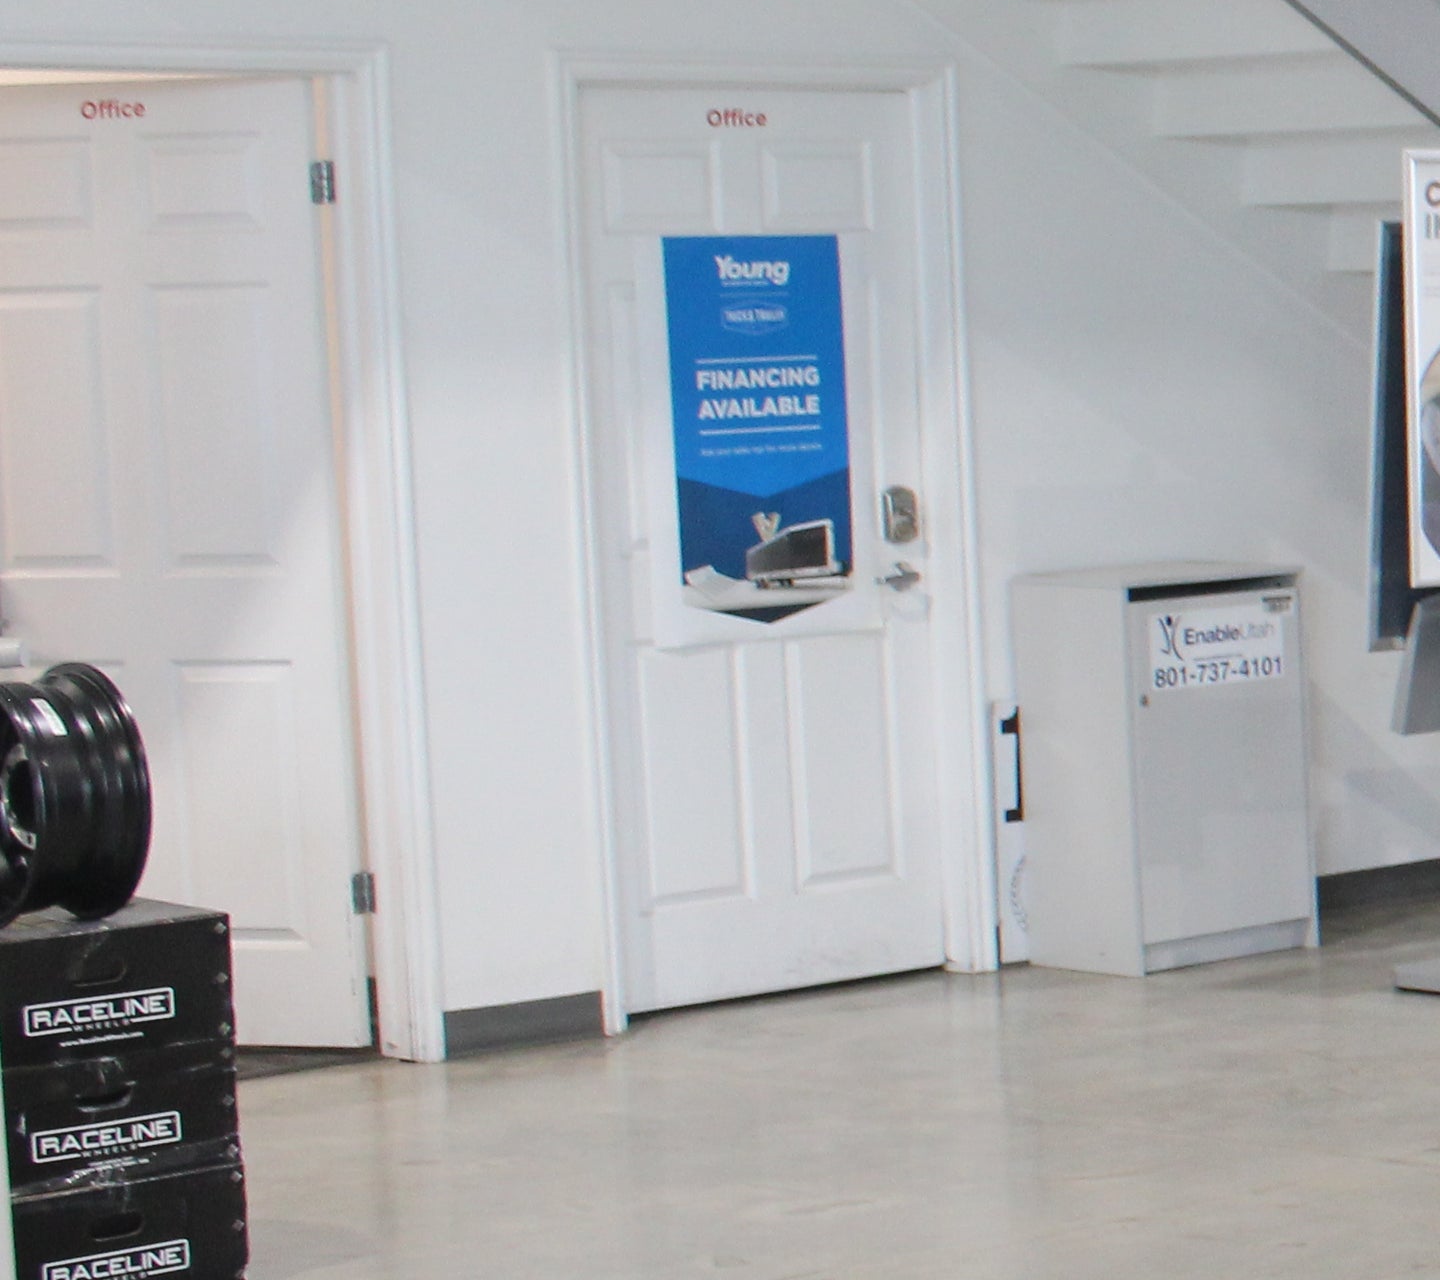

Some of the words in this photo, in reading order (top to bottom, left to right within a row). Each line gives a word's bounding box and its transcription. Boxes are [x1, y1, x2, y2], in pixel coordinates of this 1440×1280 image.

[81, 100, 146, 119] Office
[706, 108, 767, 128] Office
[714, 255, 789, 286] Young
[696, 366, 820, 391] FINANCING
[698, 394, 821, 419] AVAILABLE
[1154, 657, 1282, 688] 801-737-4101
[32, 994, 169, 1029] RACELINE
[41, 1118, 173, 1156] RACELINE
